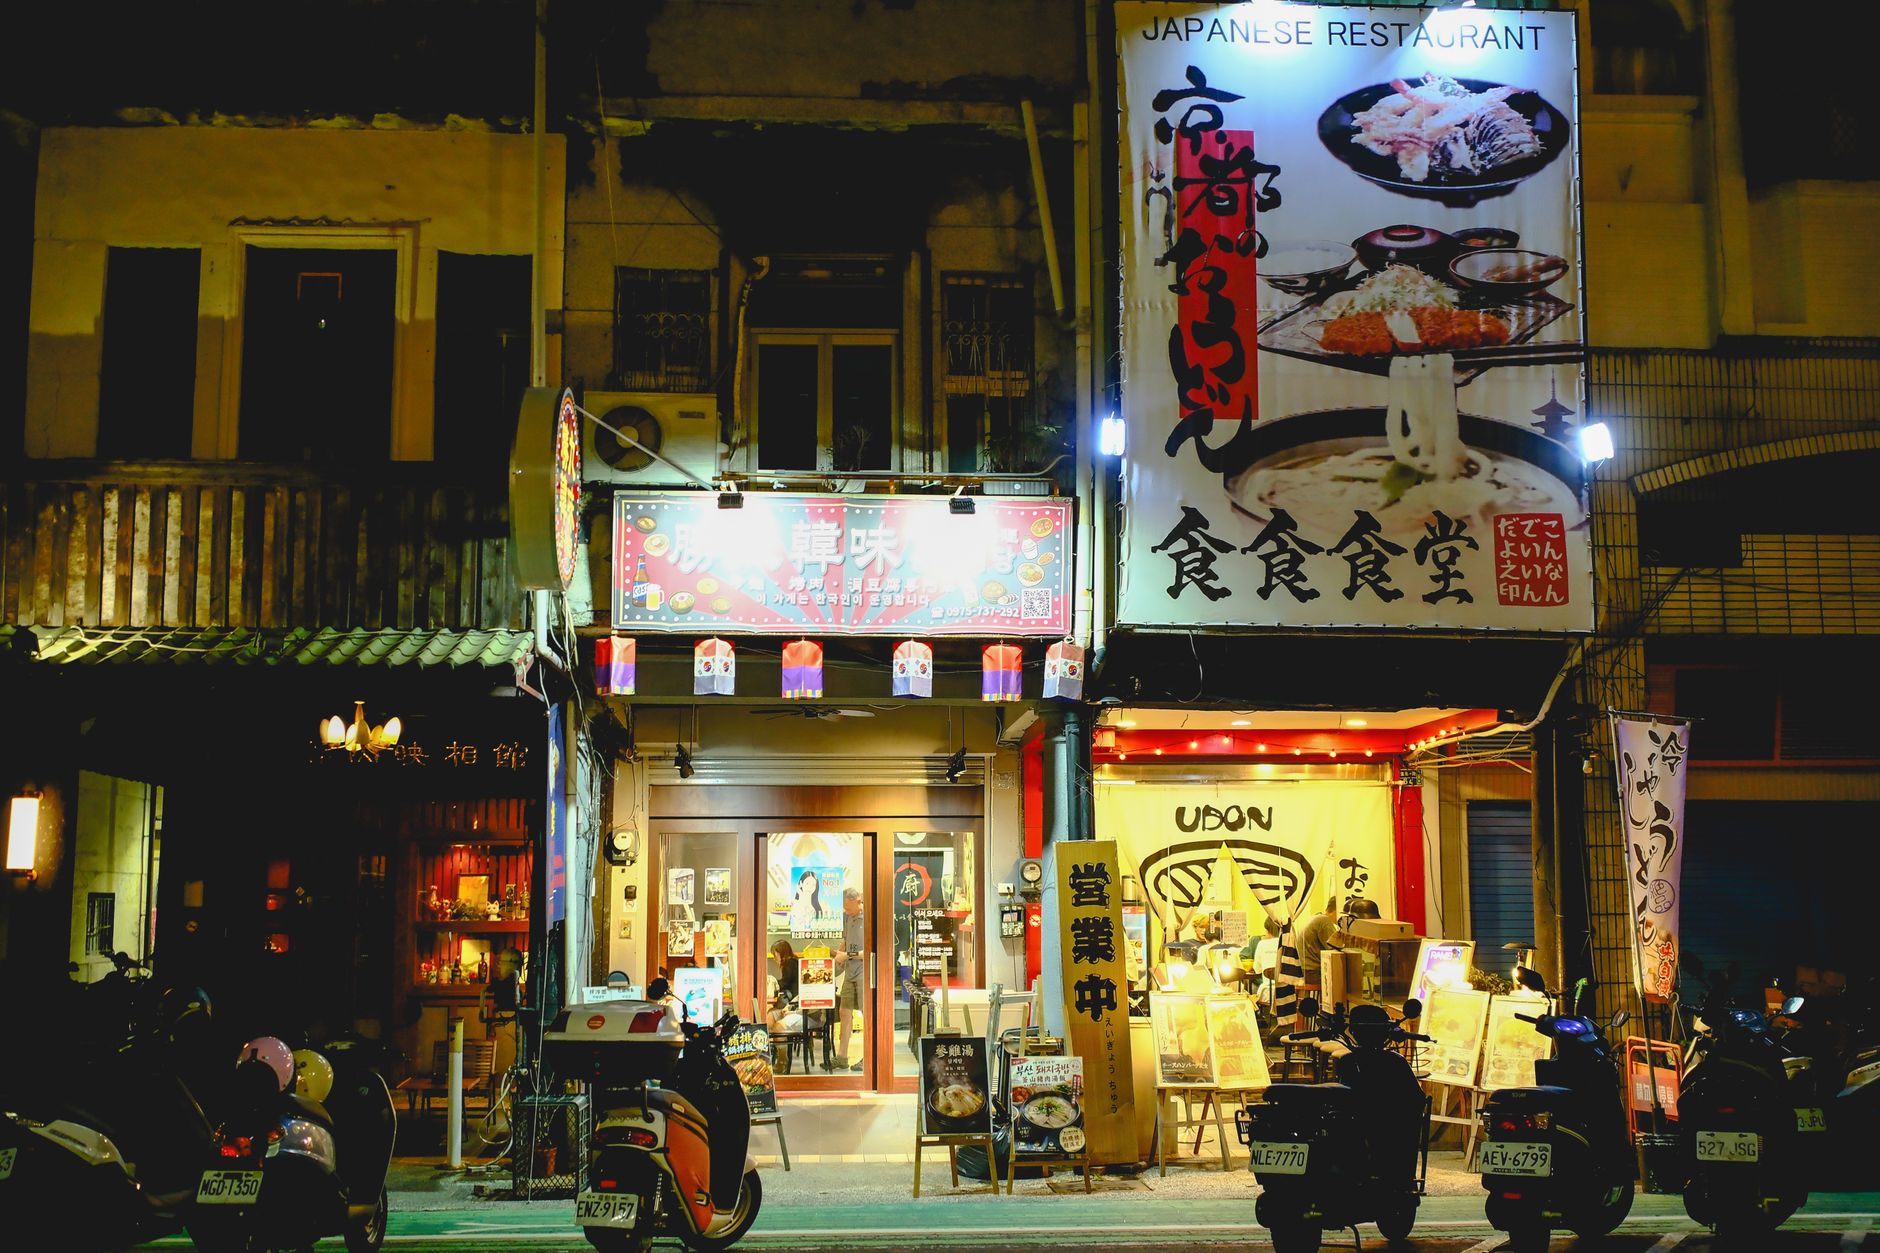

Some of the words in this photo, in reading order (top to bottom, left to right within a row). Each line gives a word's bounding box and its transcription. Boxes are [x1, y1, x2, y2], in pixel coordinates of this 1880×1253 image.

[1141, 15, 1313, 46] JAPANESE
[1327, 21, 1546, 51] RESTAURANT
[1151, 505, 1480, 605] 食食食堂
[772, 593, 809, 606] 가게는
[814, 594, 864, 607] 한국인이
[869, 595, 930, 608] 운영합니다
[946, 606, 1020, 618] 0975-737-292
[1175, 804, 1273, 833] UDON
[1068, 861, 1119, 1023] 営業中
[1698, 1140, 1725, 1156] 527
[1728, 1141, 1756, 1157] JSG
